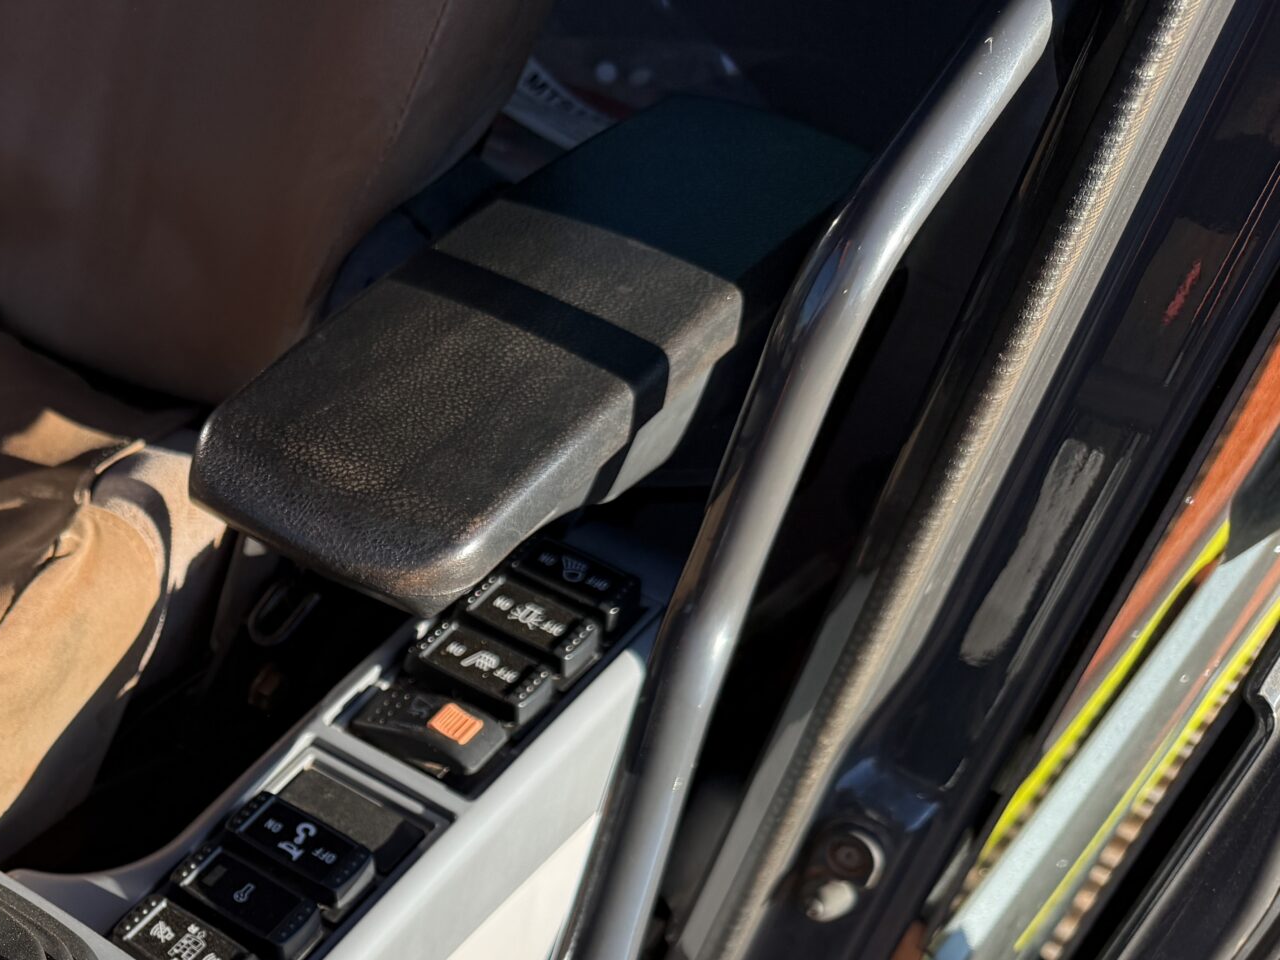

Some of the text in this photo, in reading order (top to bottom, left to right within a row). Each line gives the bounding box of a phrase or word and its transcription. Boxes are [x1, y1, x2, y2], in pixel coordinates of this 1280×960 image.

[492, 594, 515, 611] ON
[539, 620, 567, 637] OFF
[445, 640, 467, 657] ON
[493, 666, 520, 684] OFF
[263, 818, 284, 834] ON
[311, 847, 338, 865] OFF
